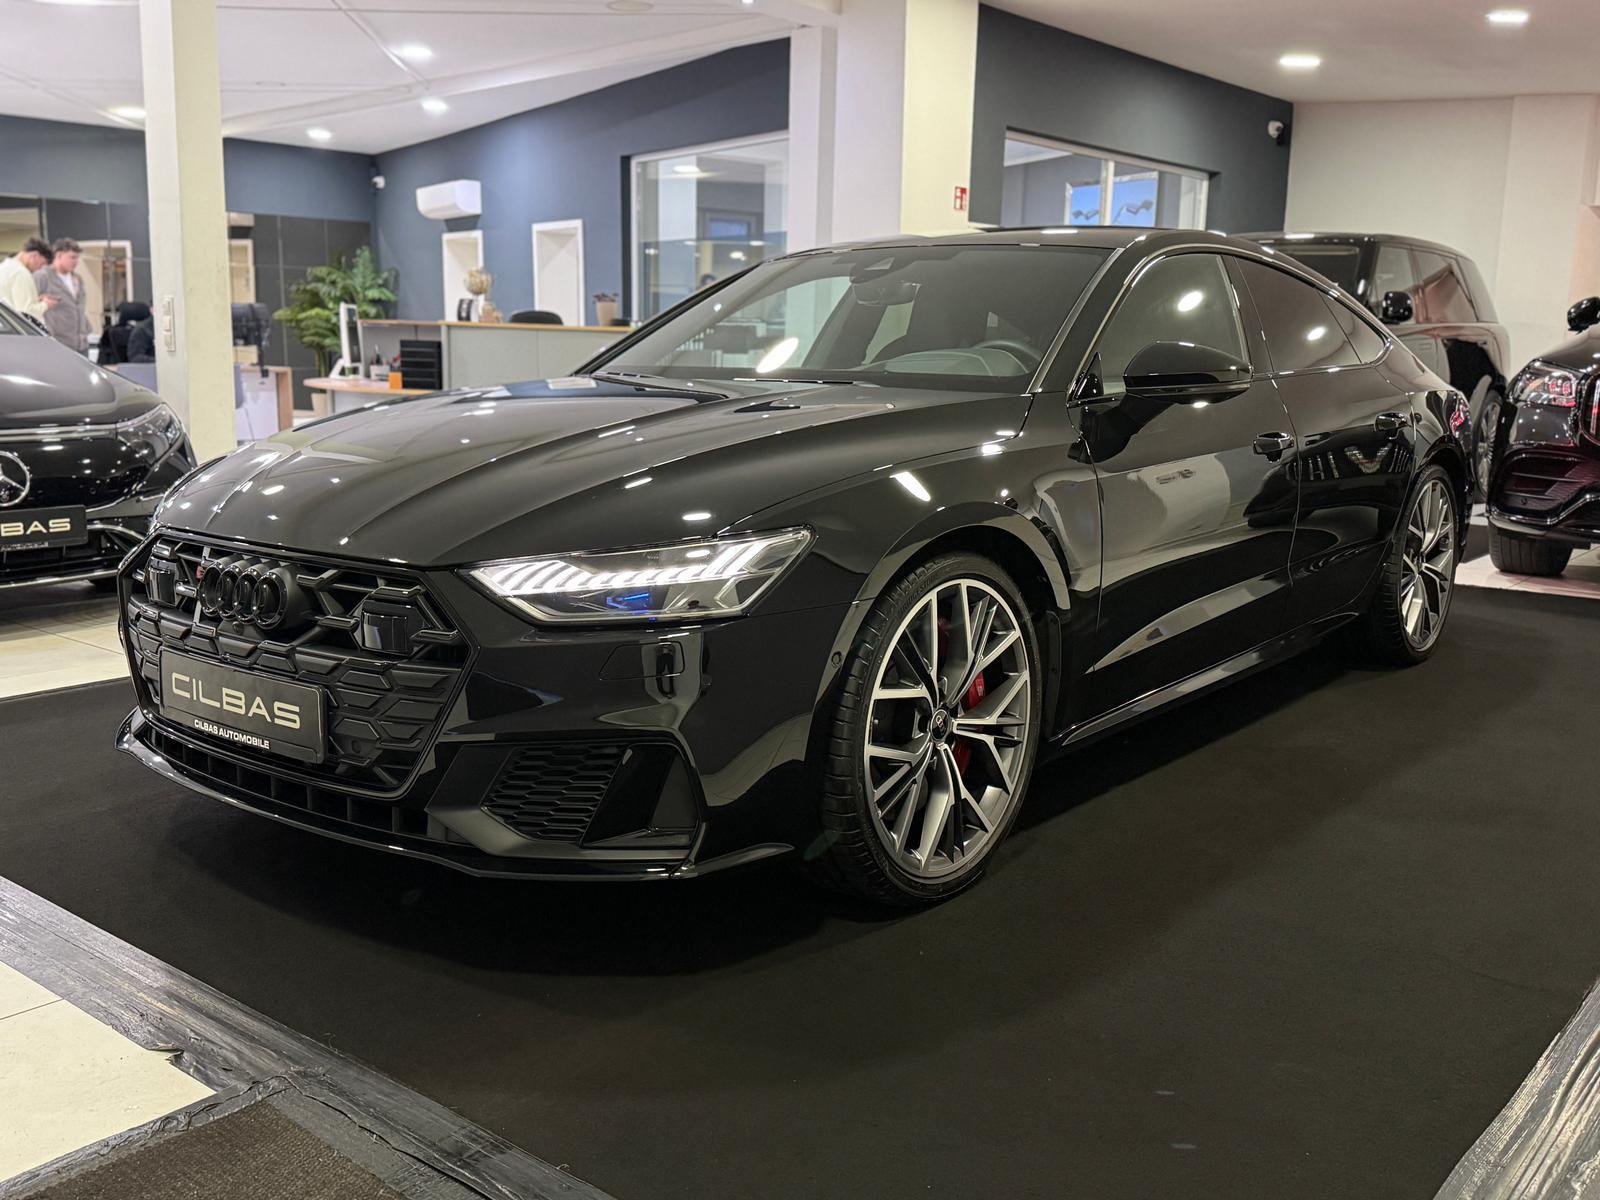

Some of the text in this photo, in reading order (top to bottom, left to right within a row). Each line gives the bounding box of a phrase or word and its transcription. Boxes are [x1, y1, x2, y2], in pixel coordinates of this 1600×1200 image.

[171, 673, 301, 730] CILBAS
[194, 719, 270, 750] CILBAS AUTOMOBILE
